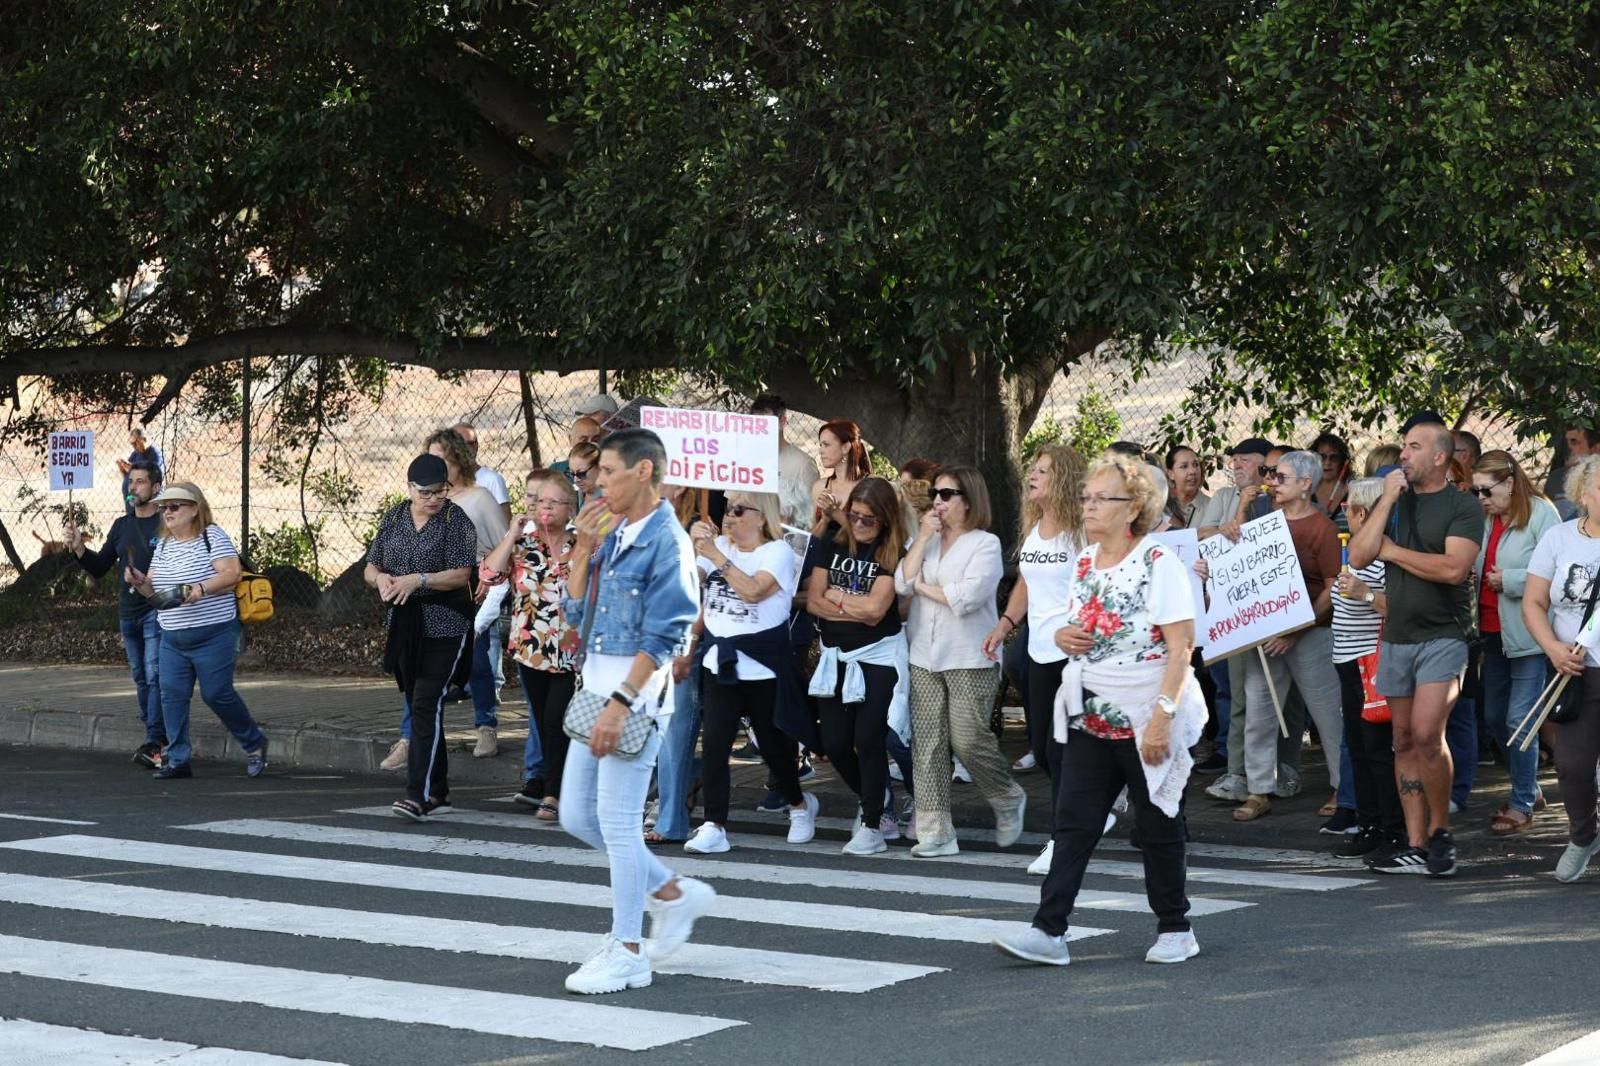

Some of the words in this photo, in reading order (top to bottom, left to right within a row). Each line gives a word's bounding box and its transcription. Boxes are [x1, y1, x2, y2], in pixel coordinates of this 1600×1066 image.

[642, 410, 769, 435] REHABILITAR
[52, 435, 86, 450] BARRIO
[682, 437, 719, 455] LOS
[61, 471, 74, 486] YA
[830, 553, 880, 578] LOVE
[1226, 577, 1260, 607] FUERA
[1260, 554, 1297, 586] ESTE?
